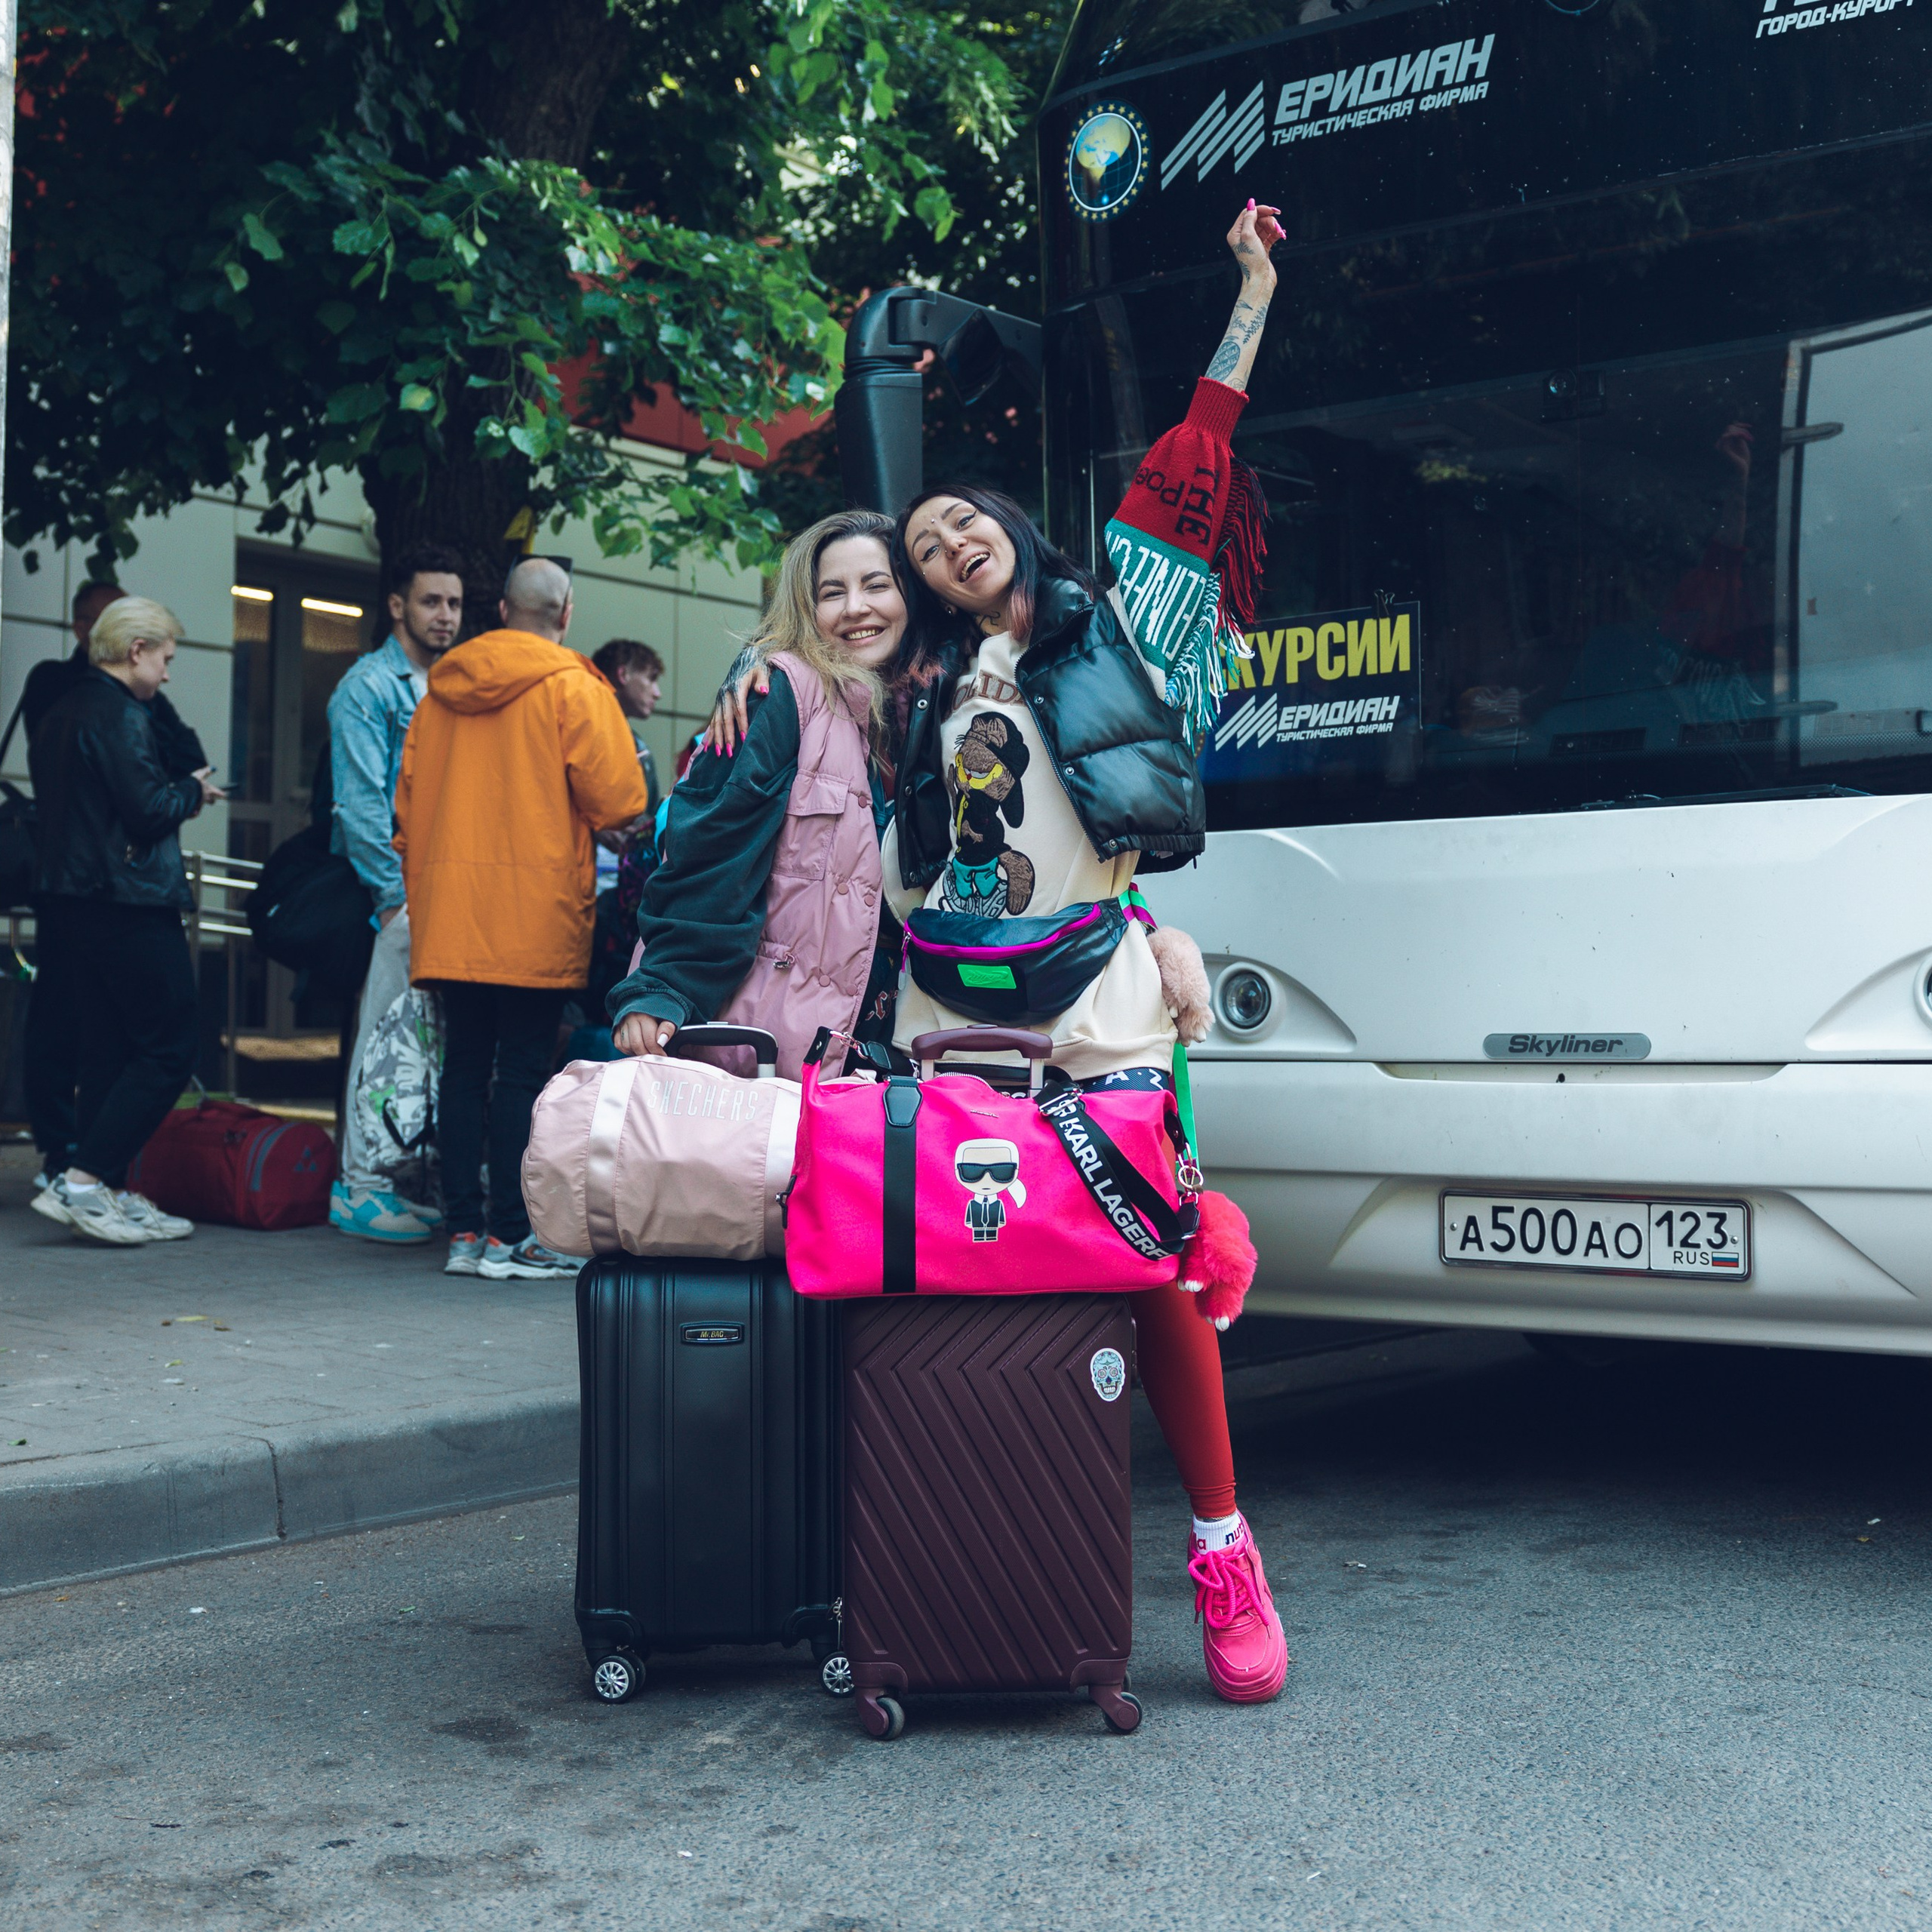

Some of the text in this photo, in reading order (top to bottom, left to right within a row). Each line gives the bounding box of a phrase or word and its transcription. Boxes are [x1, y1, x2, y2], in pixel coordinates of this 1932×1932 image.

[1274, 34, 1496, 125] ЕРИДИАН
[1272, 82, 1490, 146] ТУРИСТИЧЕСКАЯ ФИРМА
[1210, 614, 1411, 691] КУРСИИ
[1276, 722, 1394, 743] ТУРИСТИЧЕСКАЯ ФИРМА
[1278, 695, 1401, 731] ЕРИДИАН
[1508, 1035, 1623, 1057] Skyliner
[647, 1080, 759, 1121] SKECHERS
[1059, 1117, 1173, 1260] KARL LAGERF
[1654, 1210, 1728, 1250] 123
[1673, 1251, 1710, 1266] RUS
